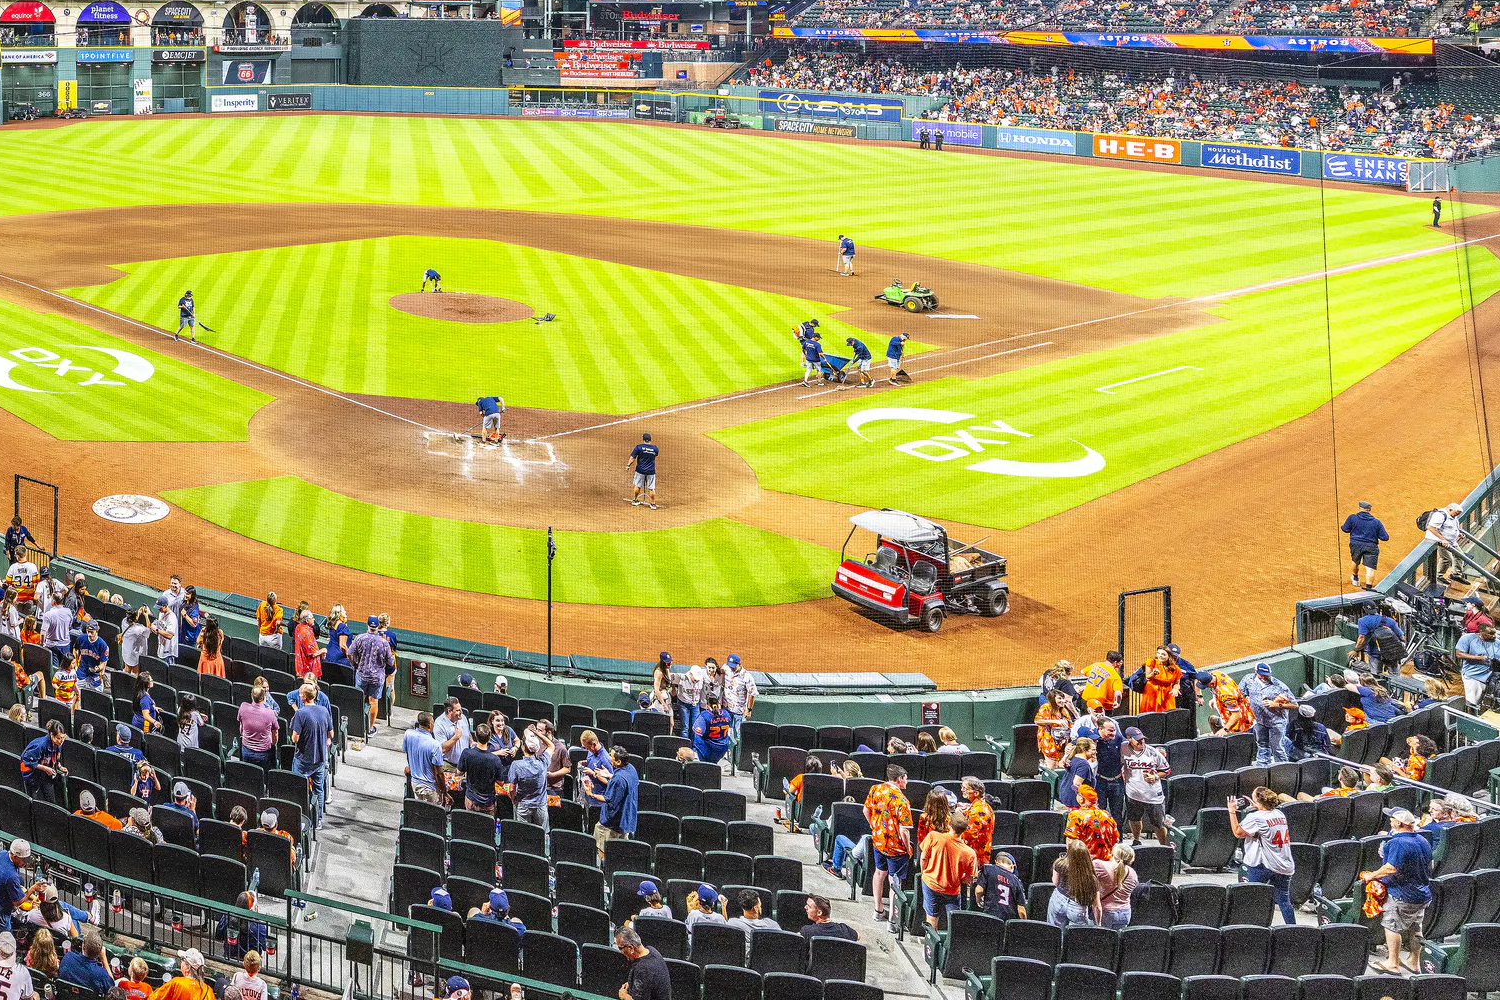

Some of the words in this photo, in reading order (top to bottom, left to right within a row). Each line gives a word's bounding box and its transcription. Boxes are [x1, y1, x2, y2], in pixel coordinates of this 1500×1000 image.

[91, 5, 114, 14] planet
[93, 11, 118, 19] fitness
[622, 10, 679, 20] Budweiser
[589, 40, 633, 48] Budweiser
[658, 41, 697, 49] Budweiser
[168, 51, 197, 59] EMCJET
[573, 61, 618, 69] Budweiser
[223, 98, 255, 108] Insperity
[779, 121, 799, 132] SPACE
[799, 122, 814, 133] CITY
[813, 126, 828, 134] HOME
[828, 127, 853, 136] NETWORK
[946, 129, 978, 139] mobile
[1013, 135, 1074, 148] HONDA
[1099, 138, 1175, 159] H-E-B
[1208, 146, 1241, 154] HOUSTON
[1208, 152, 1292, 171] Methodist
[1355, 159, 1407, 171] ENERG
[1355, 168, 1408, 181] TRANS
[8, 347, 128, 387] OXY
[894, 419, 1035, 462] OXY
[14, 575, 31, 587] 34
[1087, 672, 1105, 688] 27
[709, 725, 730, 738] 27
[1124, 759, 1153, 769] Twins
[1272, 830, 1290, 848] 44
[997, 885, 1011, 904] 3
